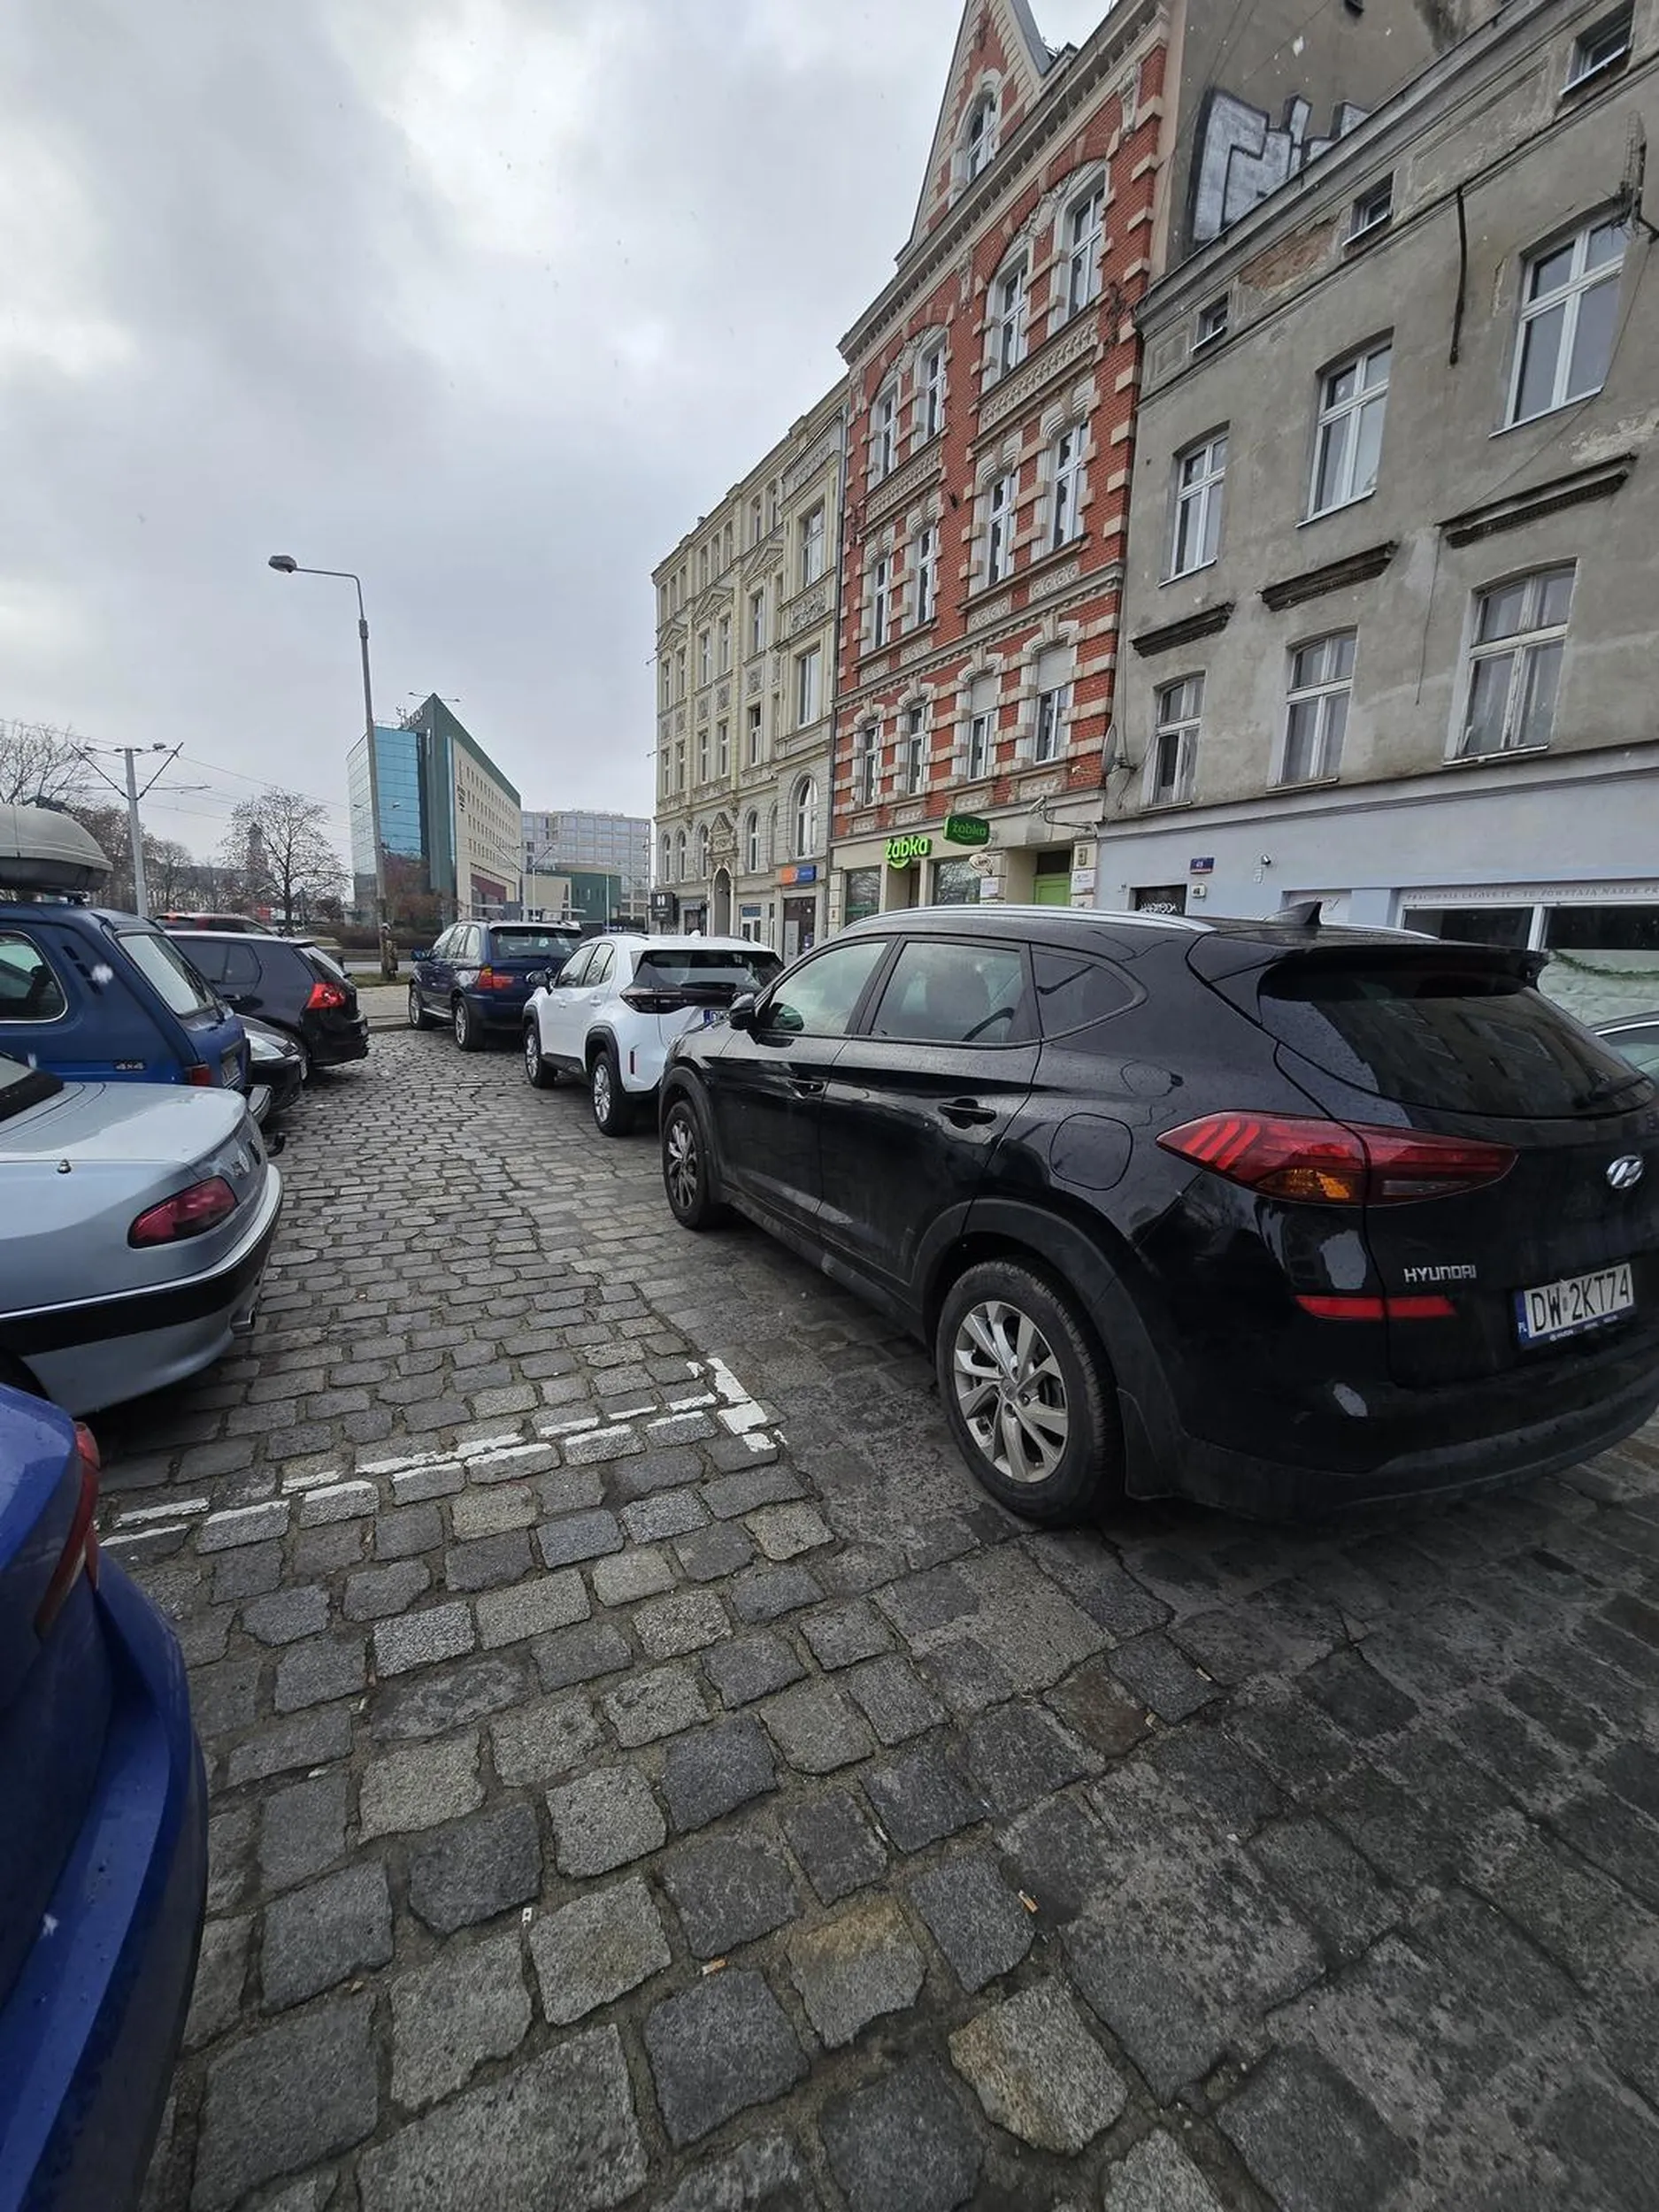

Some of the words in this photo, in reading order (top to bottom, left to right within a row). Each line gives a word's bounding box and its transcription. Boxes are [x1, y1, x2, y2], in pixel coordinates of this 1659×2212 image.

[952, 821, 987, 837] żabka
[885, 835, 929, 860] żabka
[1403, 1264, 1477, 1283] HYUNDAI
